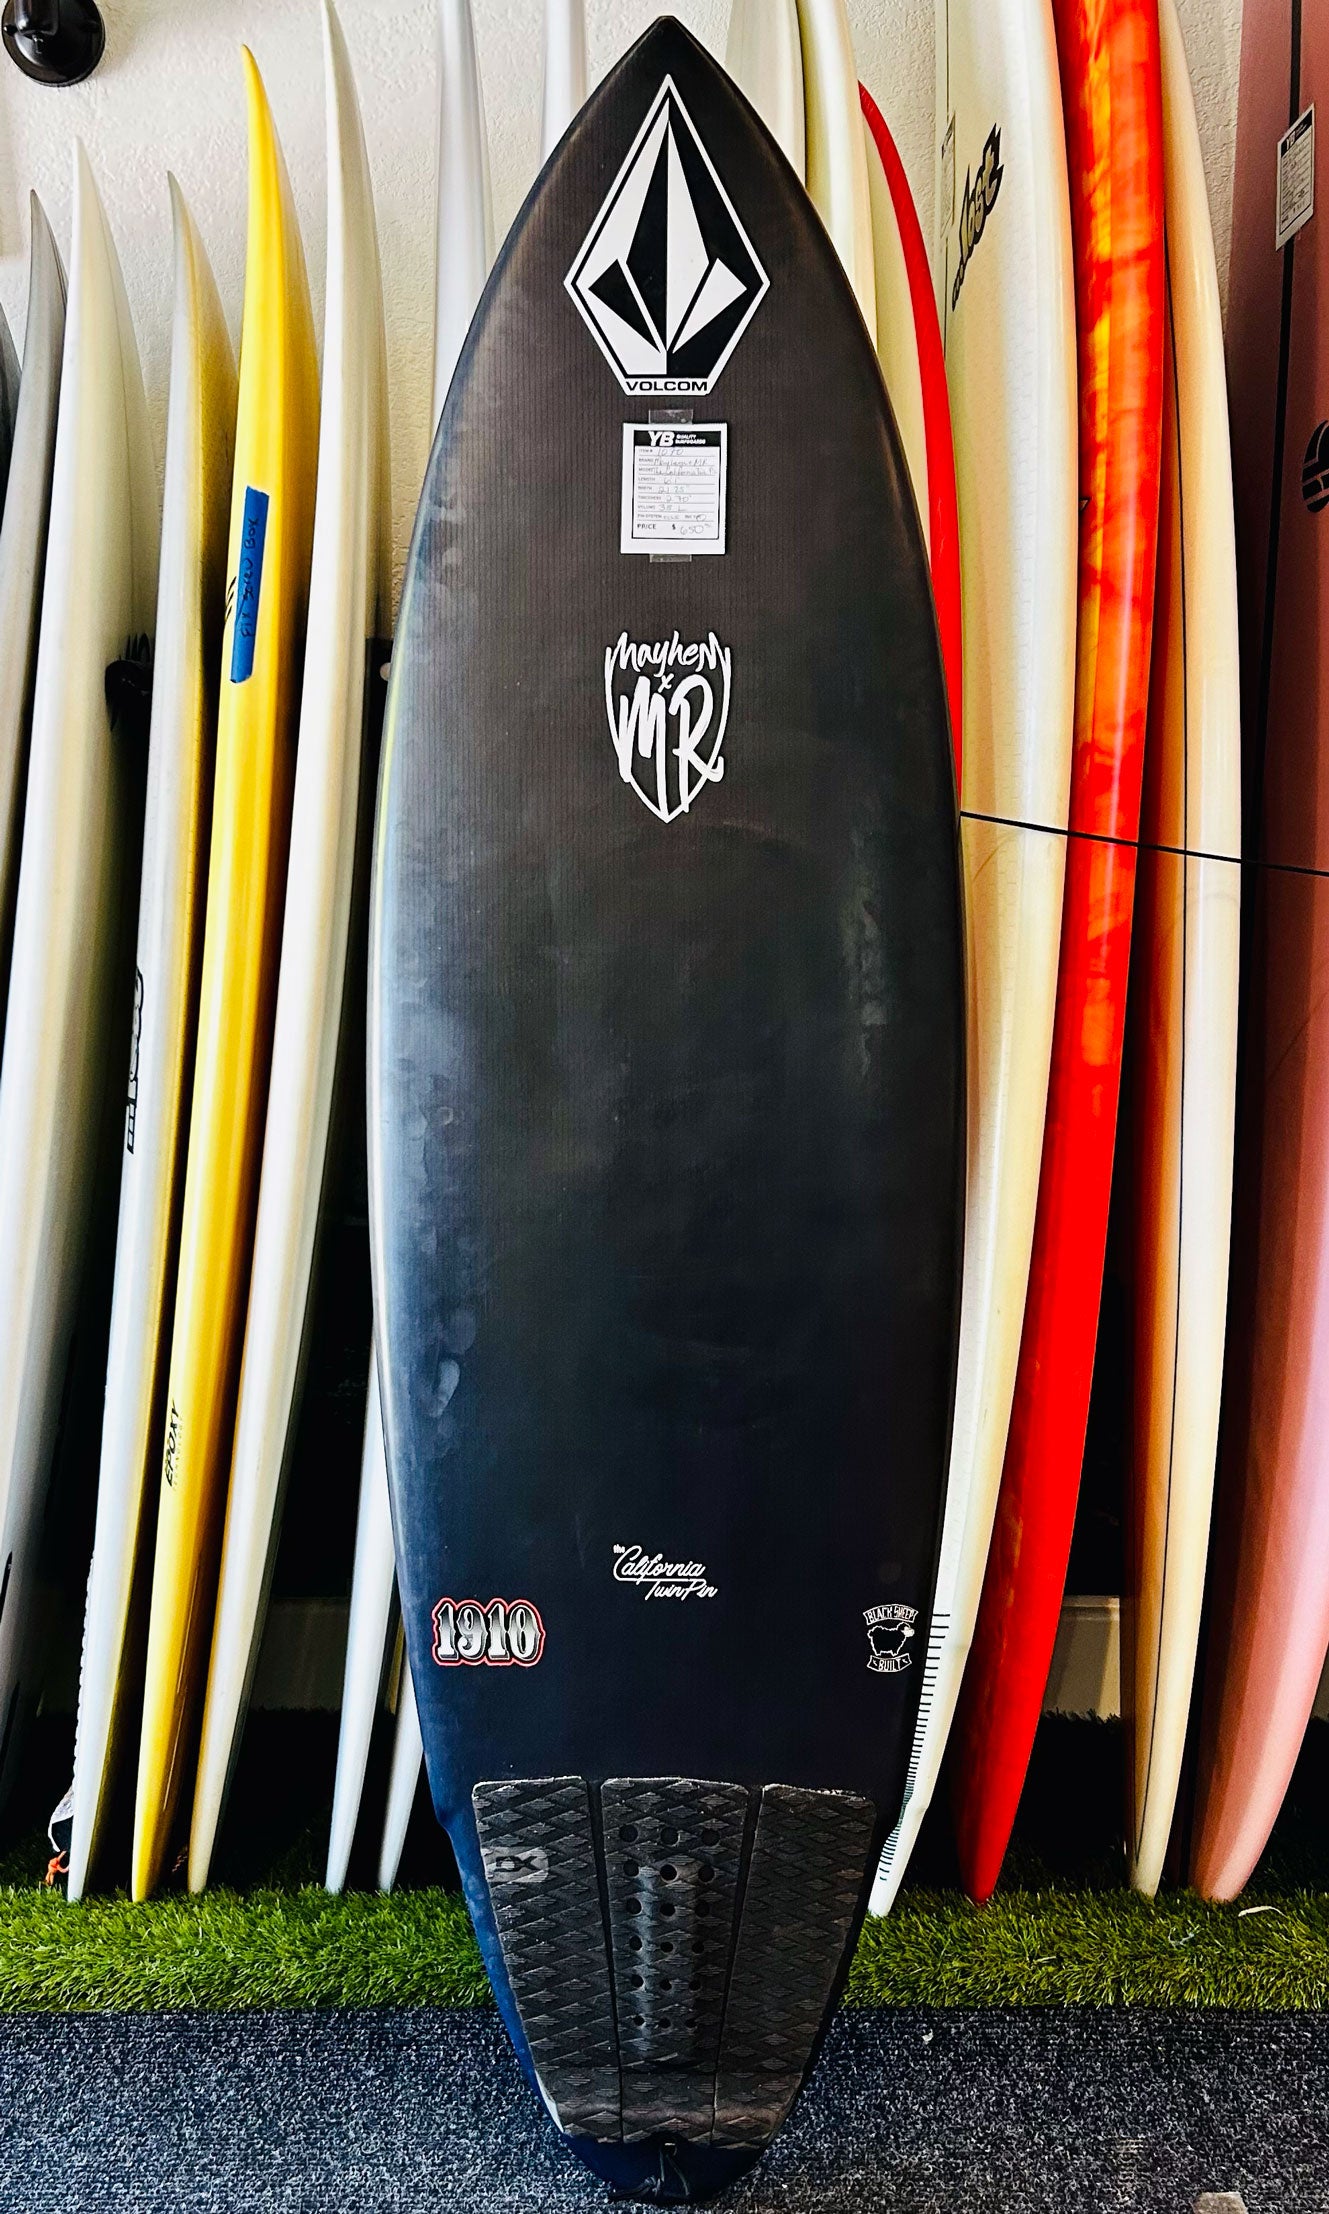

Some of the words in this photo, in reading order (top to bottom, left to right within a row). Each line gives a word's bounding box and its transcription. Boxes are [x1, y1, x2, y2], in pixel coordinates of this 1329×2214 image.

[626, 381, 708, 391] VOLCOM
[648, 430, 676, 447] YB
[672, 523, 677, 531] $
[618, 674, 724, 815] MR
[164, 1399, 179, 1487] EPOXY
[613, 1545, 706, 1585] California
[867, 1607, 893, 1622] BLACK
[893, 1606, 914, 1620] SHEEP
[436, 1601, 542, 1662] 1910
[879, 1658, 901, 1672] BUILT
